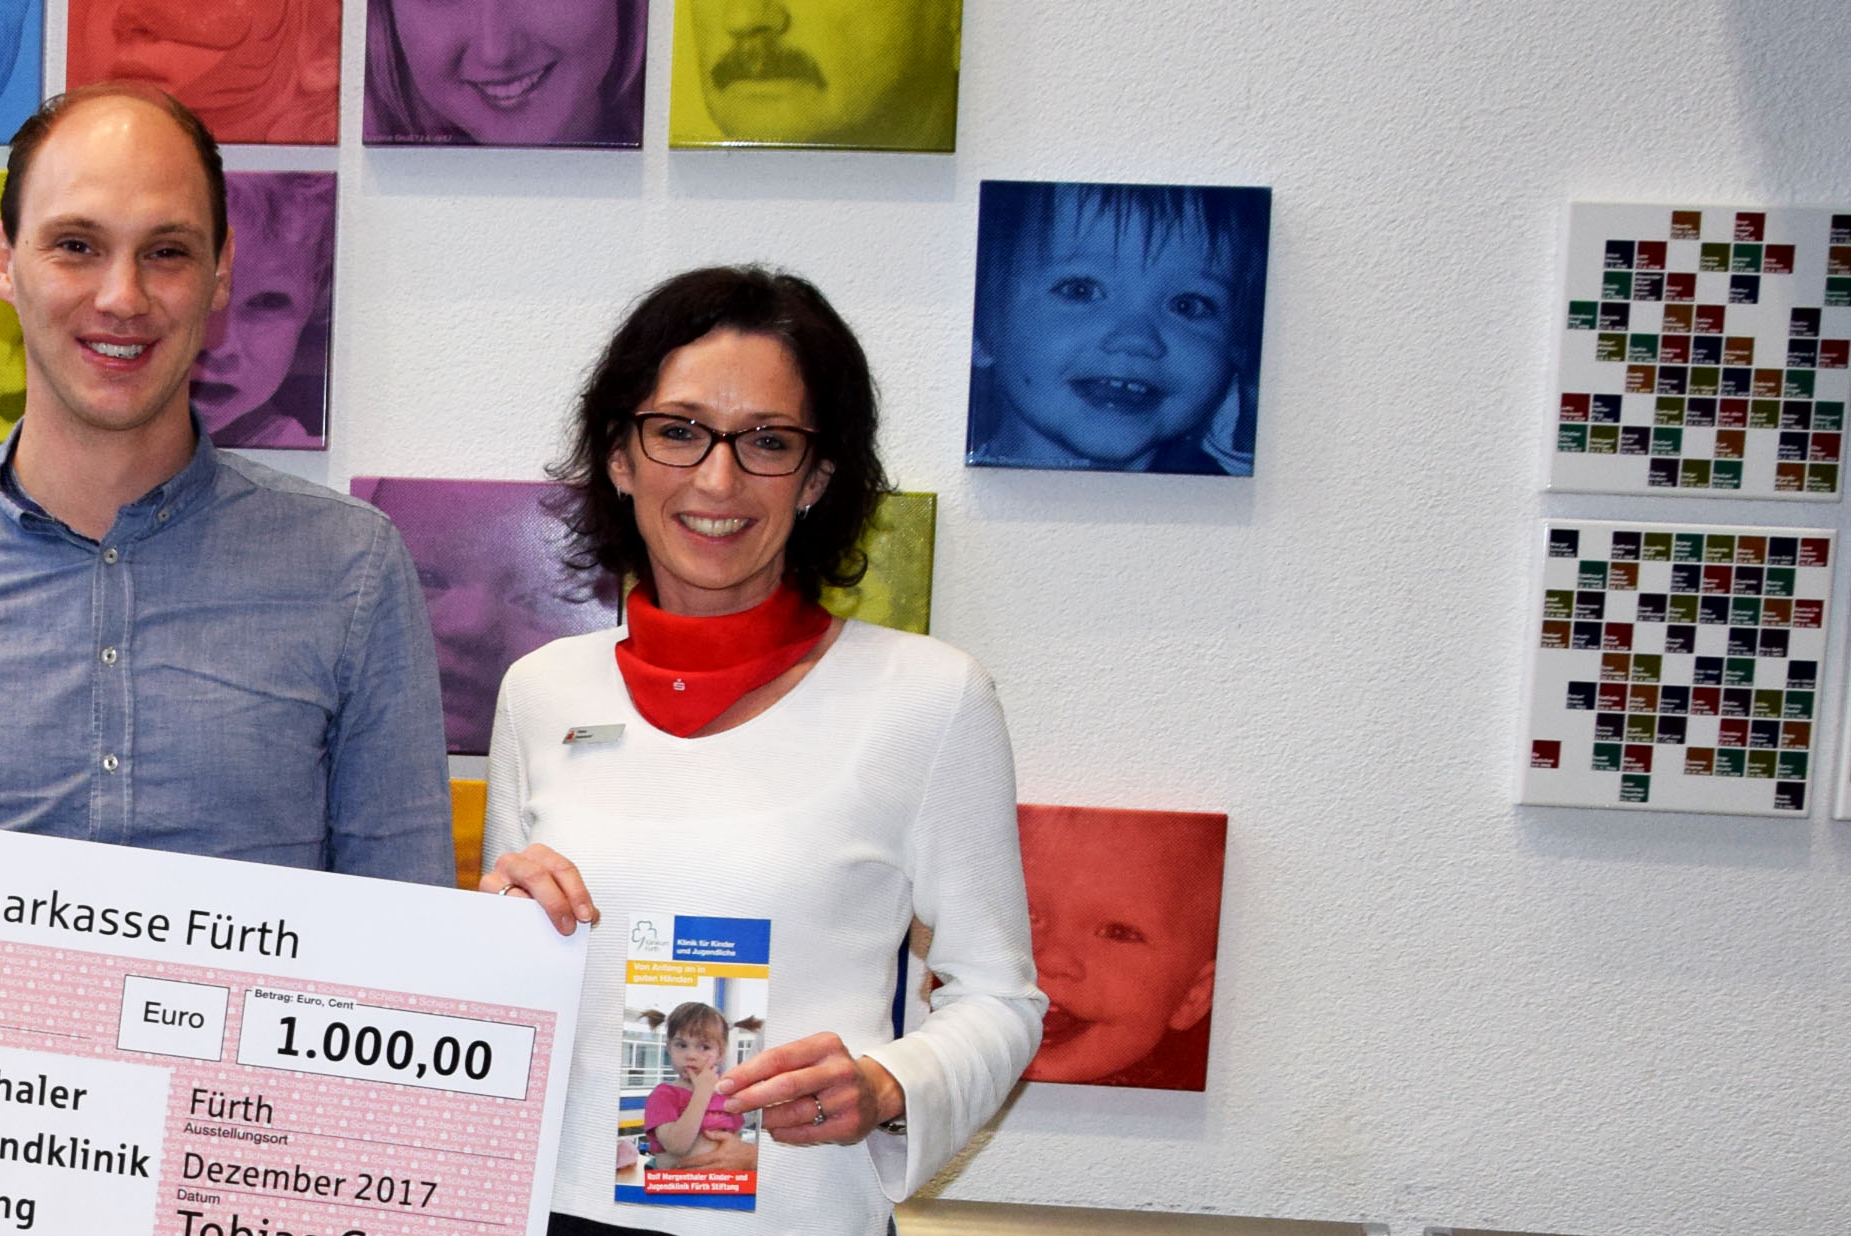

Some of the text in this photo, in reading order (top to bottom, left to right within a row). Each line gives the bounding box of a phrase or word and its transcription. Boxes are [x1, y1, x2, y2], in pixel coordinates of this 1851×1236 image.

[186, 909, 299, 959] Fürth
[676, 939, 698, 947] Klinik
[699, 939, 710, 947] für
[711, 940, 736, 949] Kinder
[692, 948, 737, 957] Jugendliche
[254, 988, 355, 1011] Betrag: Euro, Cent
[143, 1001, 205, 1029] Euro
[277, 1016, 492, 1081] 1.000,00
[190, 1088, 273, 1124] Fürth
[183, 1122, 289, 1146] Ausstellungsort
[183, 1152, 438, 1208] Dezember 2017
[647, 1182, 740, 1192] Jugendklinik Fürth Stiftung
[662, 1173, 708, 1182] Mergenthaler
[176, 1188, 221, 1205] Datum
